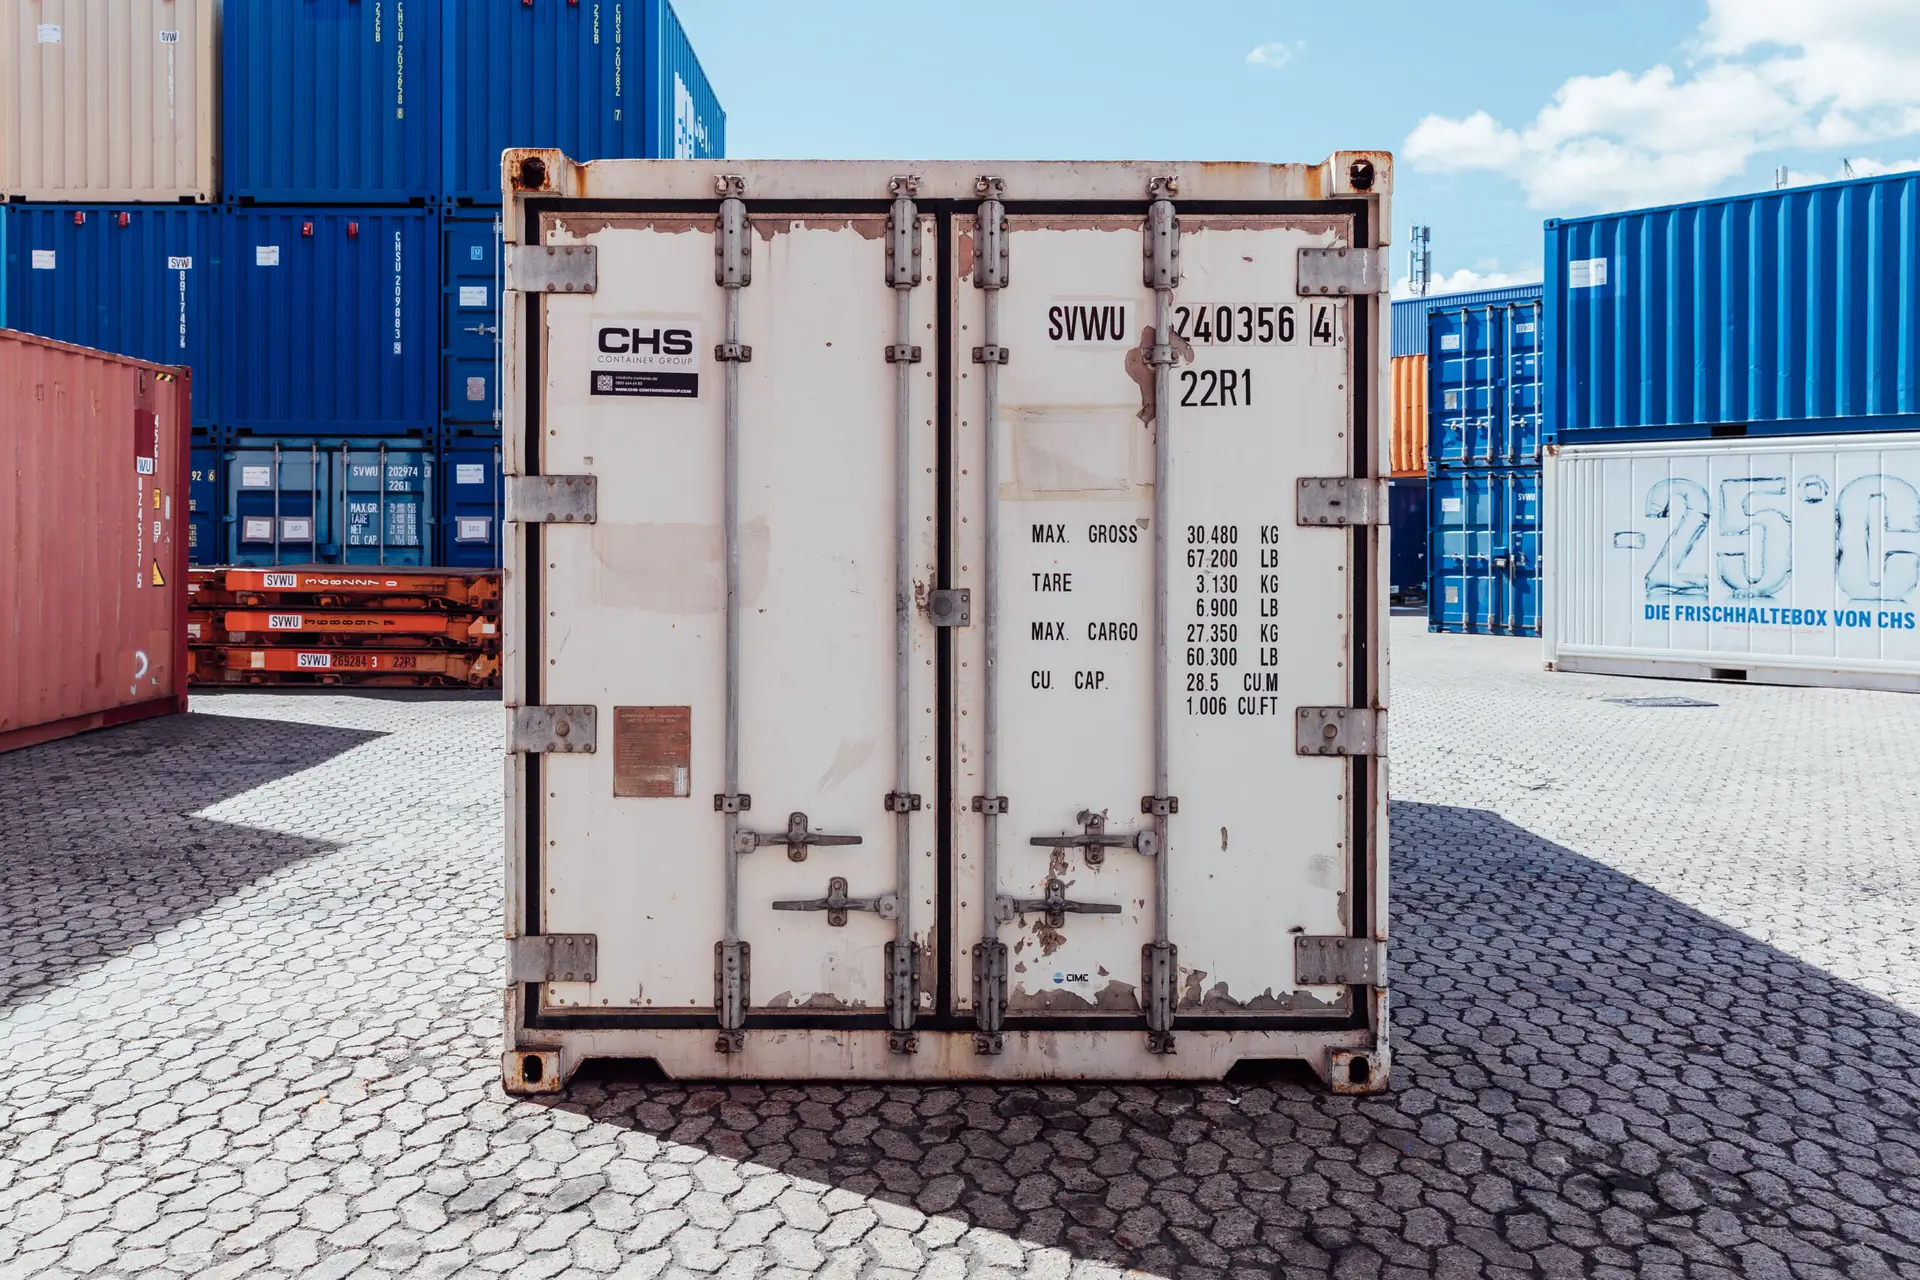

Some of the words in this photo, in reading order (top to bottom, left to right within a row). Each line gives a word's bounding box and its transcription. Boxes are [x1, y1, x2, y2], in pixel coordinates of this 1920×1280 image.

[1048, 305, 1125, 341] SVWU
[1174, 306, 1295, 343] 240356
[1313, 306, 1333, 343] 4
[598, 327, 693, 356] CHS
[597, 355, 654, 364] CONTAINER
[658, 356, 693, 366] GROUP
[1180, 368, 1251, 407] 22R1
[353, 466, 378, 477] SVWU
[388, 466, 418, 477] 202974
[389, 480, 408, 491] 22G1
[351, 514, 368, 523] TARE
[350, 524, 362, 535] NET
[1032, 524, 1070, 544] MAX.
[1088, 524, 1138, 544] GROSS
[1187, 525, 1238, 545] 30,480
[1260, 525, 1279, 545] KG
[1187, 549, 1238, 568] 67,200
[1260, 549, 1279, 568] LB
[267, 574, 294, 587] SVWU
[305, 578, 380, 586] 368227
[1031, 572, 1072, 592] TARE
[1196, 574, 1238, 594] 3,130
[1260, 574, 1279, 594] KG
[1196, 598, 1238, 617] 6,900
[1260, 598, 1279, 617] LB
[1644, 604, 1670, 621] DIE
[1675, 605, 1828, 627] FRISCHHALTEBOX
[1833, 610, 1872, 628] VON
[1878, 611, 1916, 630] CHS
[272, 616, 299, 628] SVWU
[304, 618, 378, 626] 368897
[1031, 621, 1069, 641] MAX.
[1087, 621, 1138, 641] CARGO
[1186, 623, 1238, 643] 27,350
[1260, 623, 1279, 643] KG
[300, 654, 328, 667] SVWU
[332, 654, 367, 667] 269284
[371, 655, 378, 668] 3
[1186, 647, 1238, 667] 60,300
[1260, 647, 1278, 667] LB
[1031, 670, 1054, 690] CU.
[1074, 670, 1109, 690] CAP.
[1186, 672, 1219, 692] 28.5
[1243, 672, 1279, 692] CU.M
[1186, 696, 1227, 716] 1,006
[1237, 696, 1278, 716] CU.FT
[1066, 973, 1089, 982] CIMC
